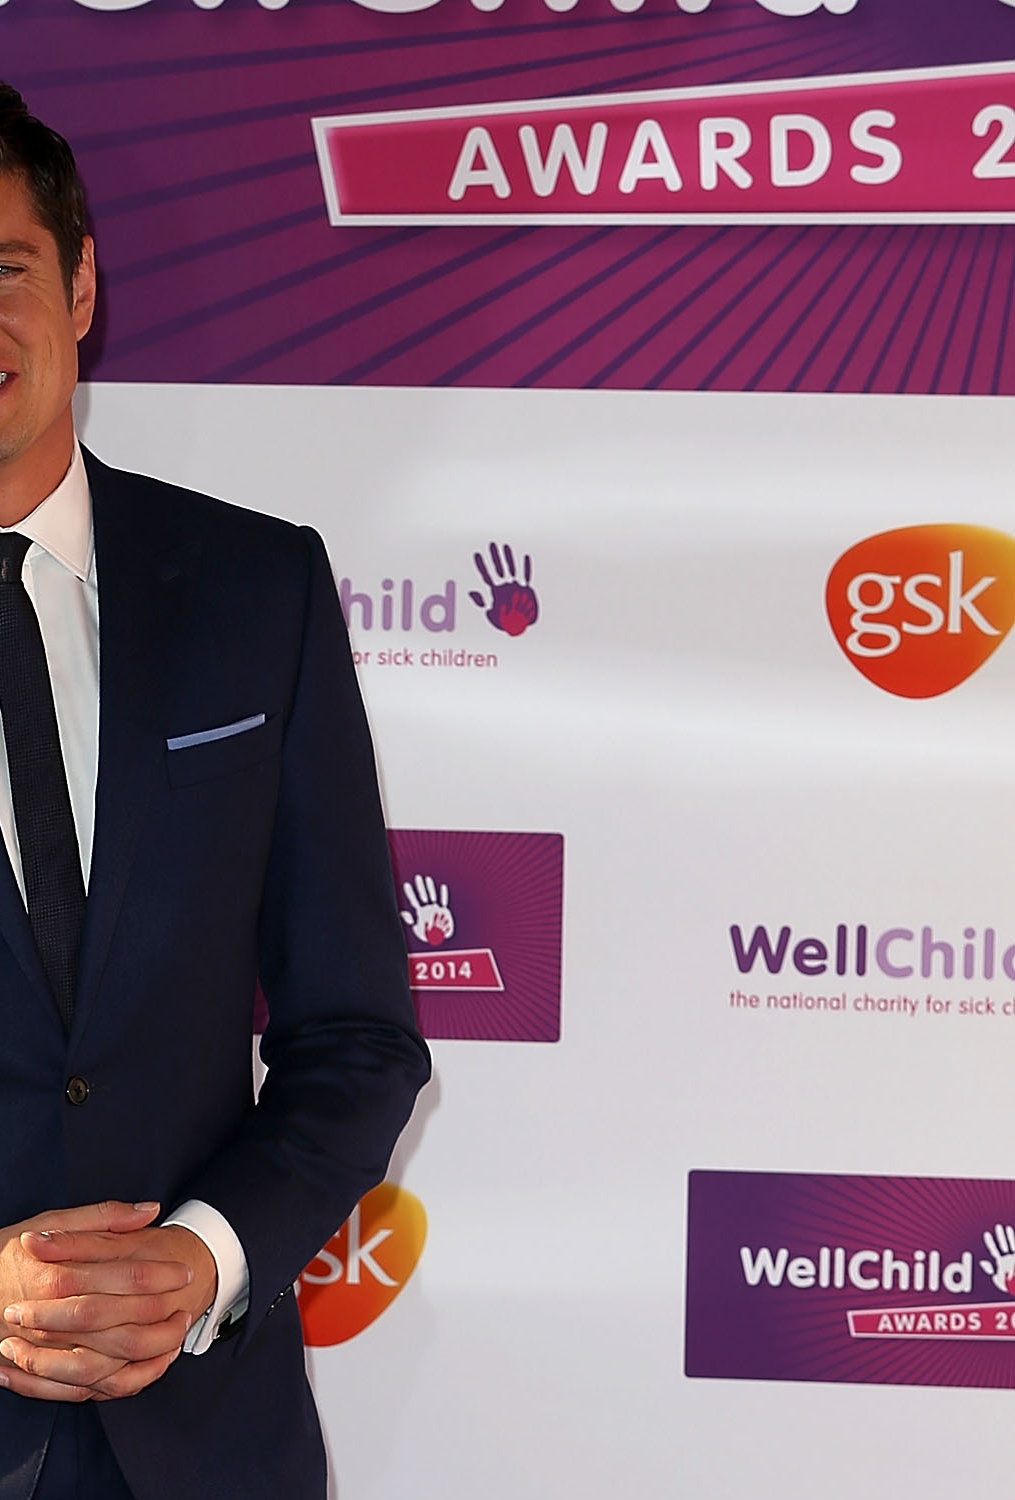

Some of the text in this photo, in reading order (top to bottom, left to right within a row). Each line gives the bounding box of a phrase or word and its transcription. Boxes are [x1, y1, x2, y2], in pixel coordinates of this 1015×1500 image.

[448, 104, 1015, 200] AWARDS 2
[846, 549, 1002, 658] gsk
[377, 648, 413, 667] sick
[420, 649, 499, 668] children
[415, 960, 472, 981] 2014
[729, 990, 760, 1009] the
[766, 992, 847, 1011] national
[853, 994, 919, 1017] charity
[925, 994, 951, 1014] for
[958, 996, 995, 1016] sick
[294, 1202, 399, 1298] sk
[739, 1246, 973, 1293] WellChild
[877, 1312, 982, 1332] AWARDS
